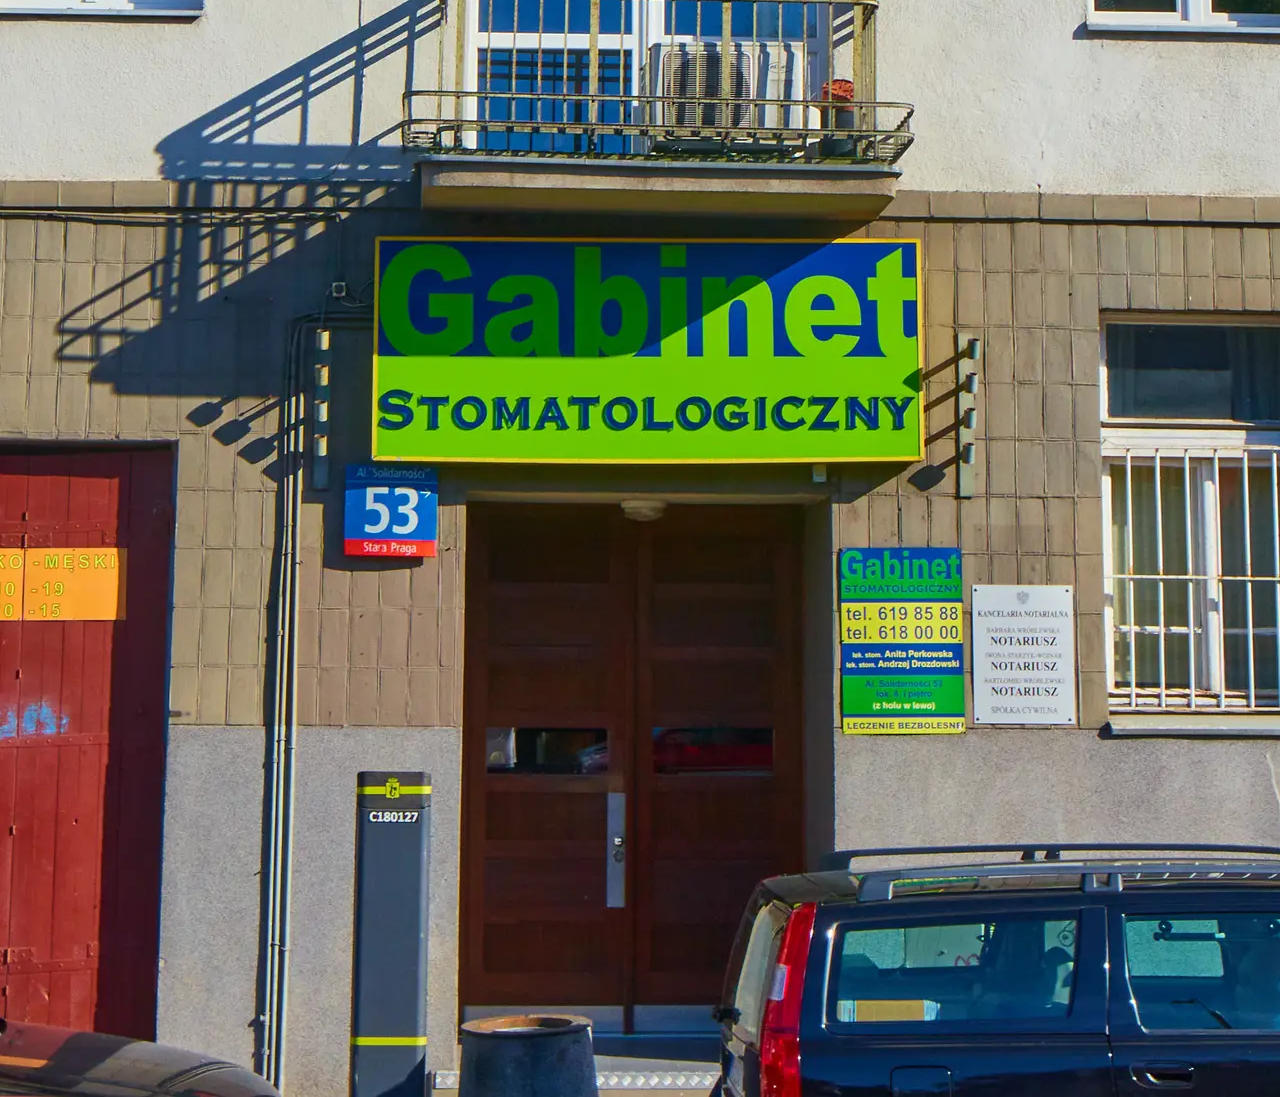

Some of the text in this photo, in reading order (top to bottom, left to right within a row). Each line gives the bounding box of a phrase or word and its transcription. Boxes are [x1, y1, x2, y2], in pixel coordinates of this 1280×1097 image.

[380, 245, 917, 357] Gabinet
[377, 389, 915, 432] STOMATOLOGICZNY
[364, 487, 419, 535] 53
[363, 542, 417, 556] Stara Praga
[841, 550, 960, 580] Gabinet
[844, 584, 960, 594] STOMATOLOGICZNY
[846, 606, 958, 621] tel. 619 85 88
[977, 610, 1069, 618] KANCELARIA NOTARIALNA
[846, 626, 959, 640] tel. 618 00 00
[990, 636, 1058, 646] NOTARIUSZ
[884, 650, 906, 658] Anita
[908, 650, 953, 658] Perkowska
[877, 660, 910, 669] Andrzej
[911, 660, 960, 668] Drozdowski
[991, 661, 1058, 671] NOTARIUSZ
[991, 686, 1059, 696] NOTARIUSZ
[991, 705, 1058, 715] SPÓŁKA CYWILNA
[847, 722, 895, 730] LECZENIE
[370, 811, 419, 822] C180127
